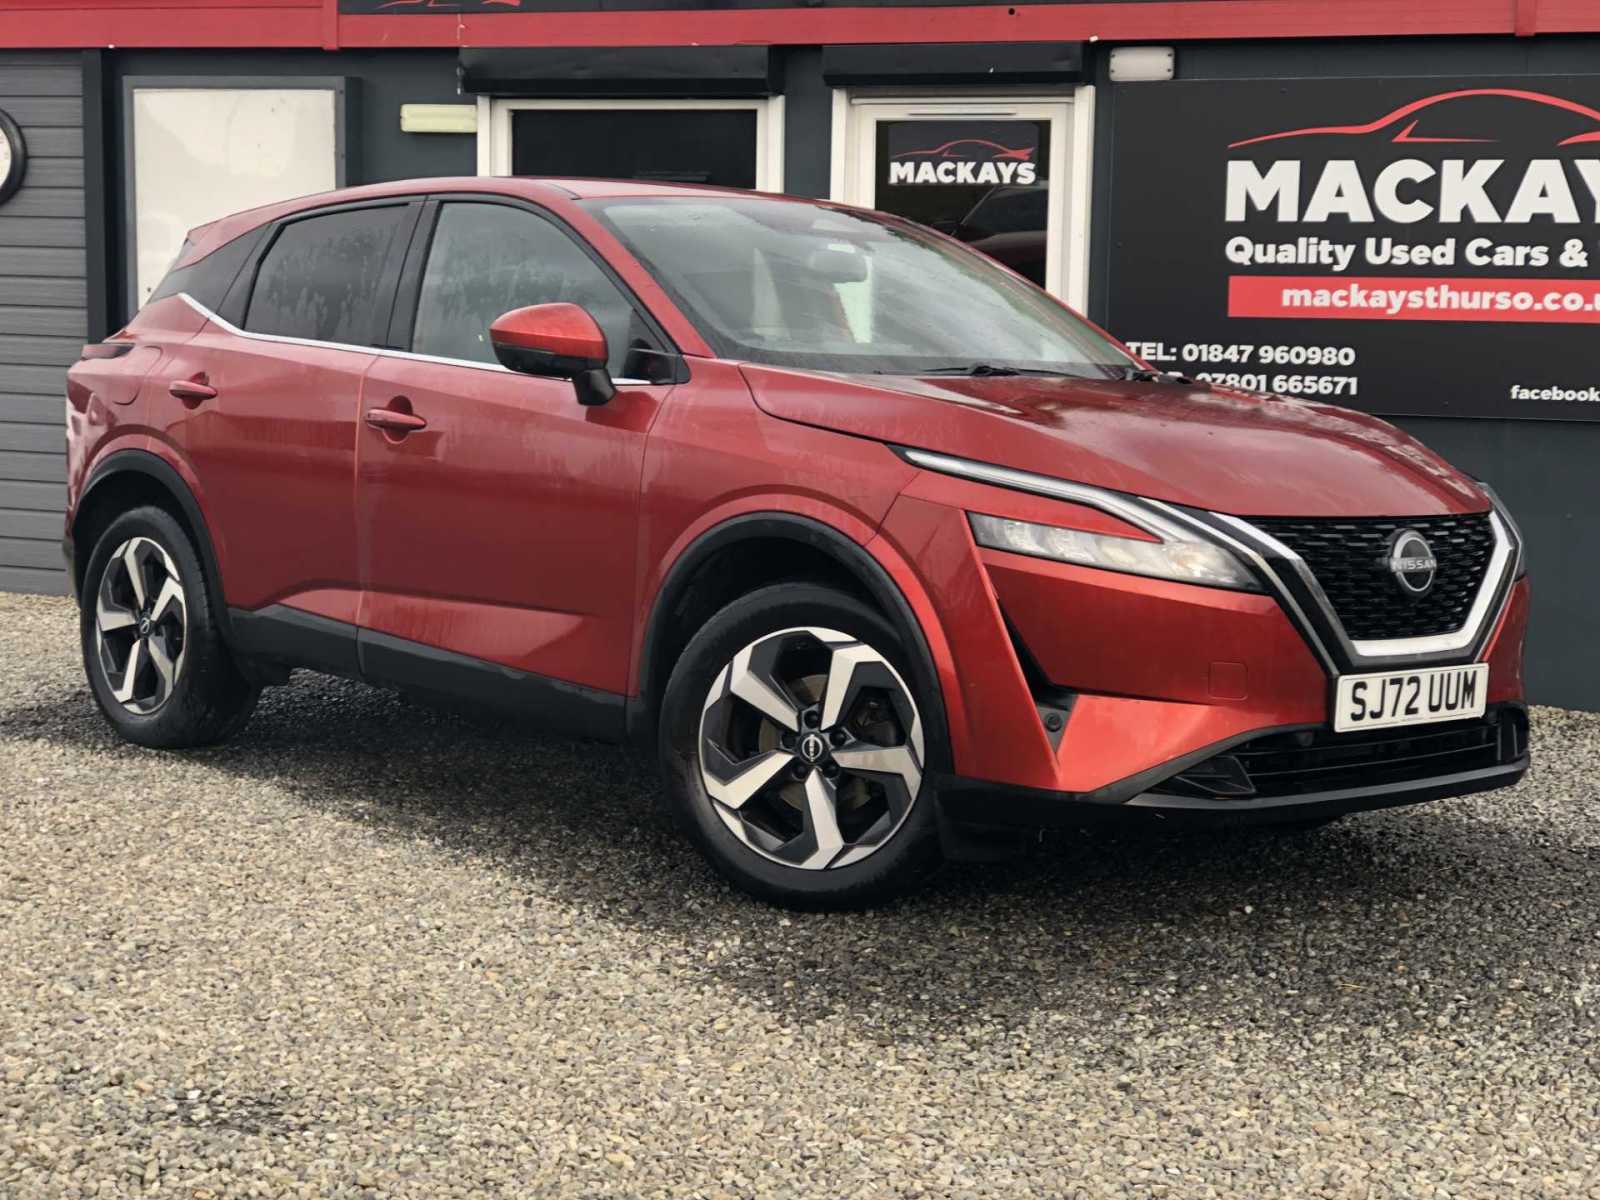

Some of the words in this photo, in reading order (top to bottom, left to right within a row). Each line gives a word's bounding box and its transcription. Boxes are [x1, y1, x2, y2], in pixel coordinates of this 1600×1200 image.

[889, 161, 1036, 184] MACKAYS
[1225, 236, 1355, 271] Quality
[1365, 238, 1455, 265] Used
[1465, 238, 1548, 267] Cars
[1559, 239, 1588, 267] &
[1126, 342, 1177, 361] TEL:
[1182, 344, 1253, 363] 01847
[1258, 346, 1355, 366] 960980
[1272, 376, 1358, 395] 665671
[1391, 558, 1437, 571] NISSAN
[1350, 676, 1421, 722] SJ72
[1428, 669, 1478, 712] UUM
